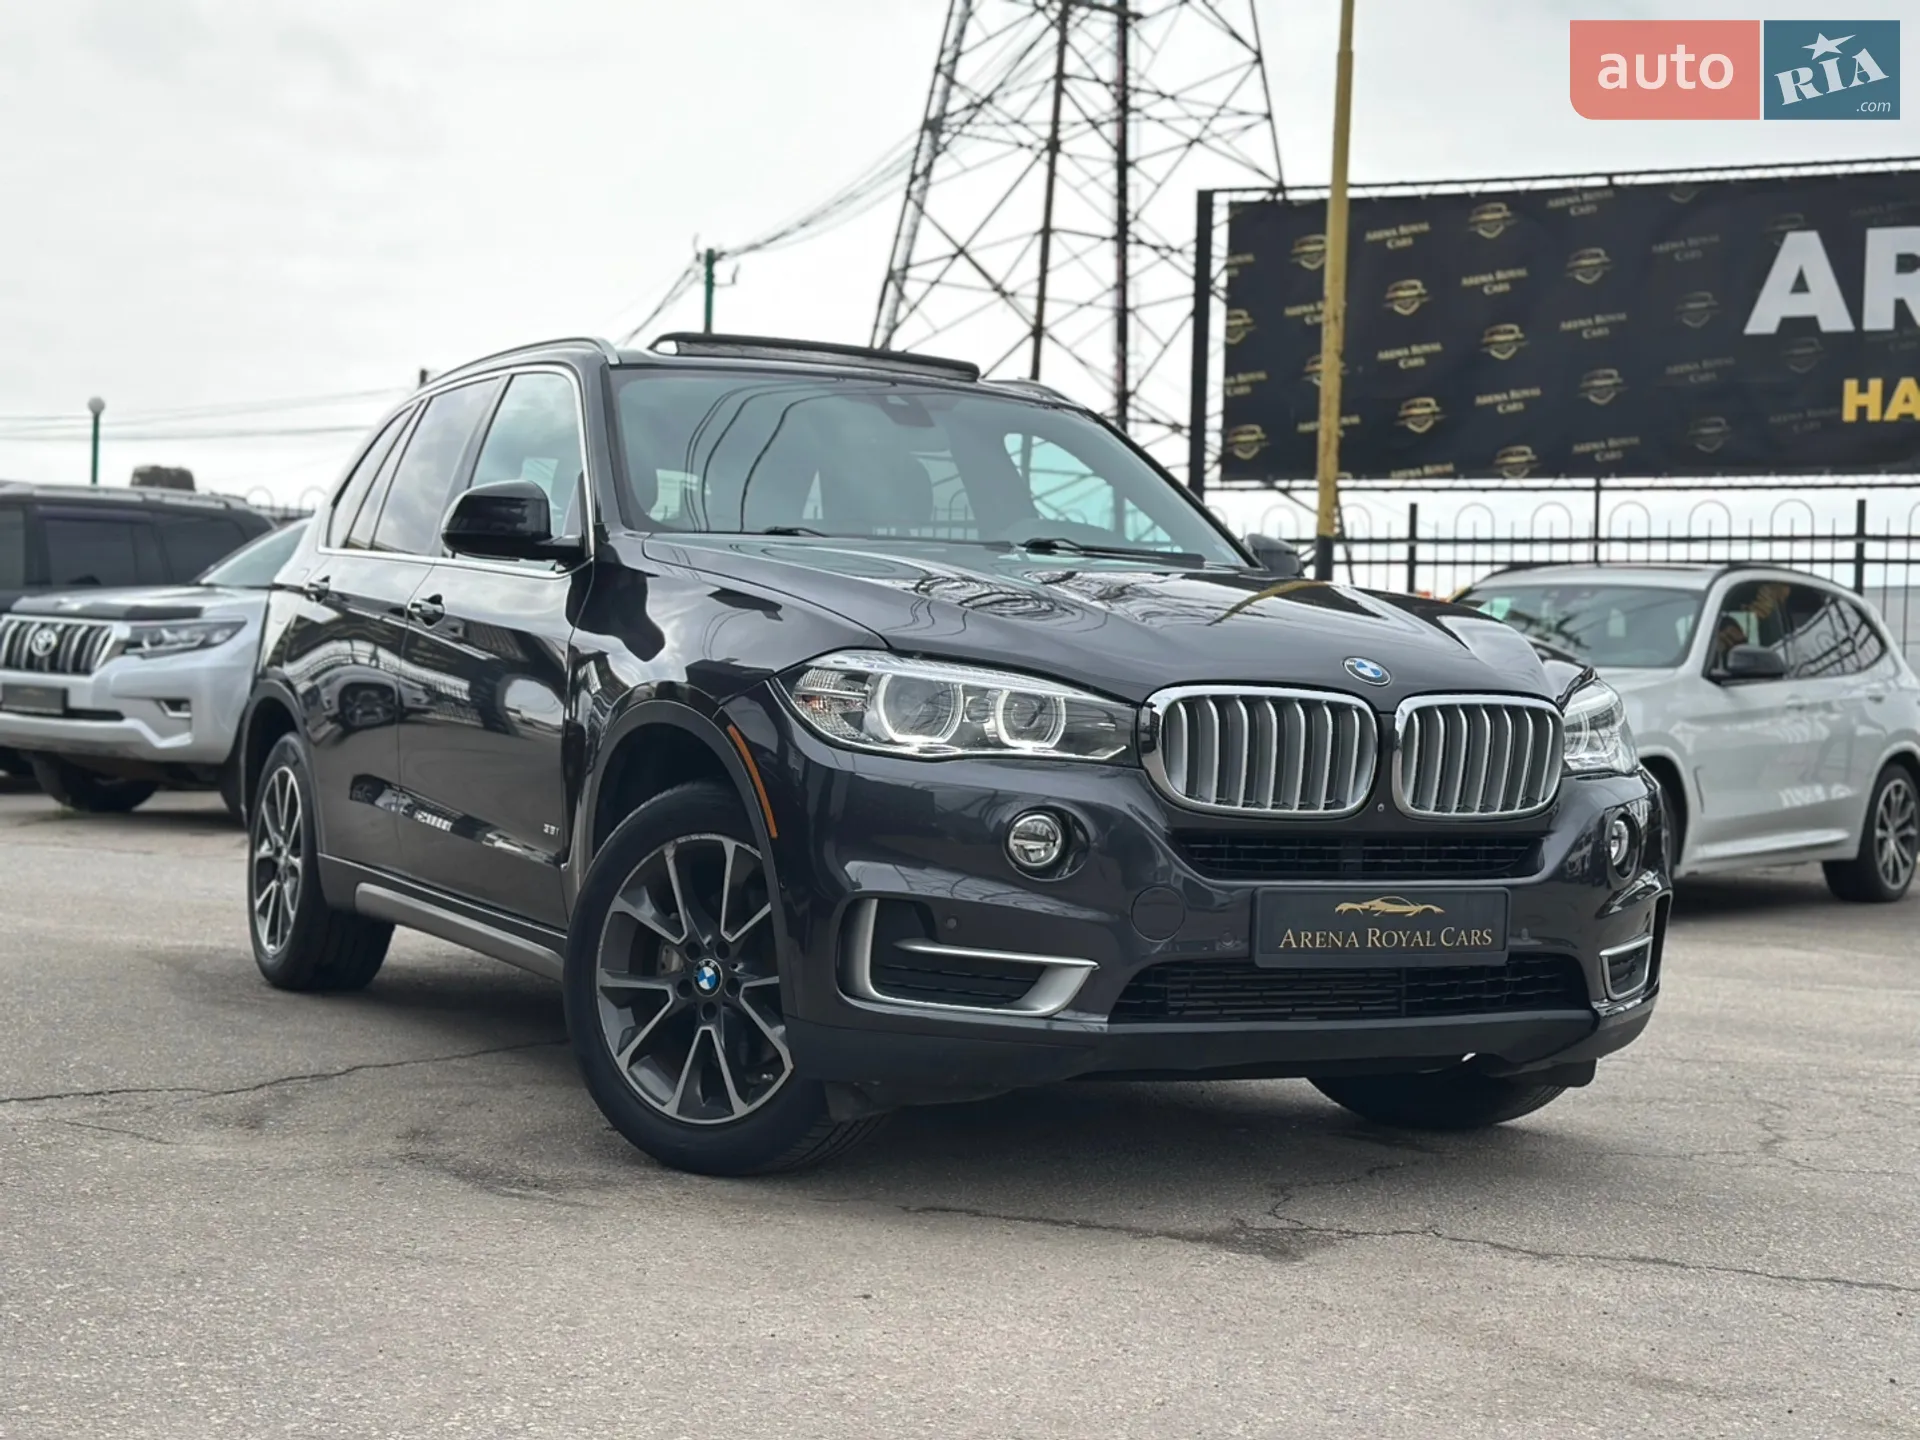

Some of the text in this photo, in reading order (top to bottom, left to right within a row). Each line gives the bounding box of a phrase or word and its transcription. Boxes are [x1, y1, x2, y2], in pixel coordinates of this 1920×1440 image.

[1743, 226, 1920, 335] AR
[1278, 926, 1493, 948] ARENA ROYAL CARS
